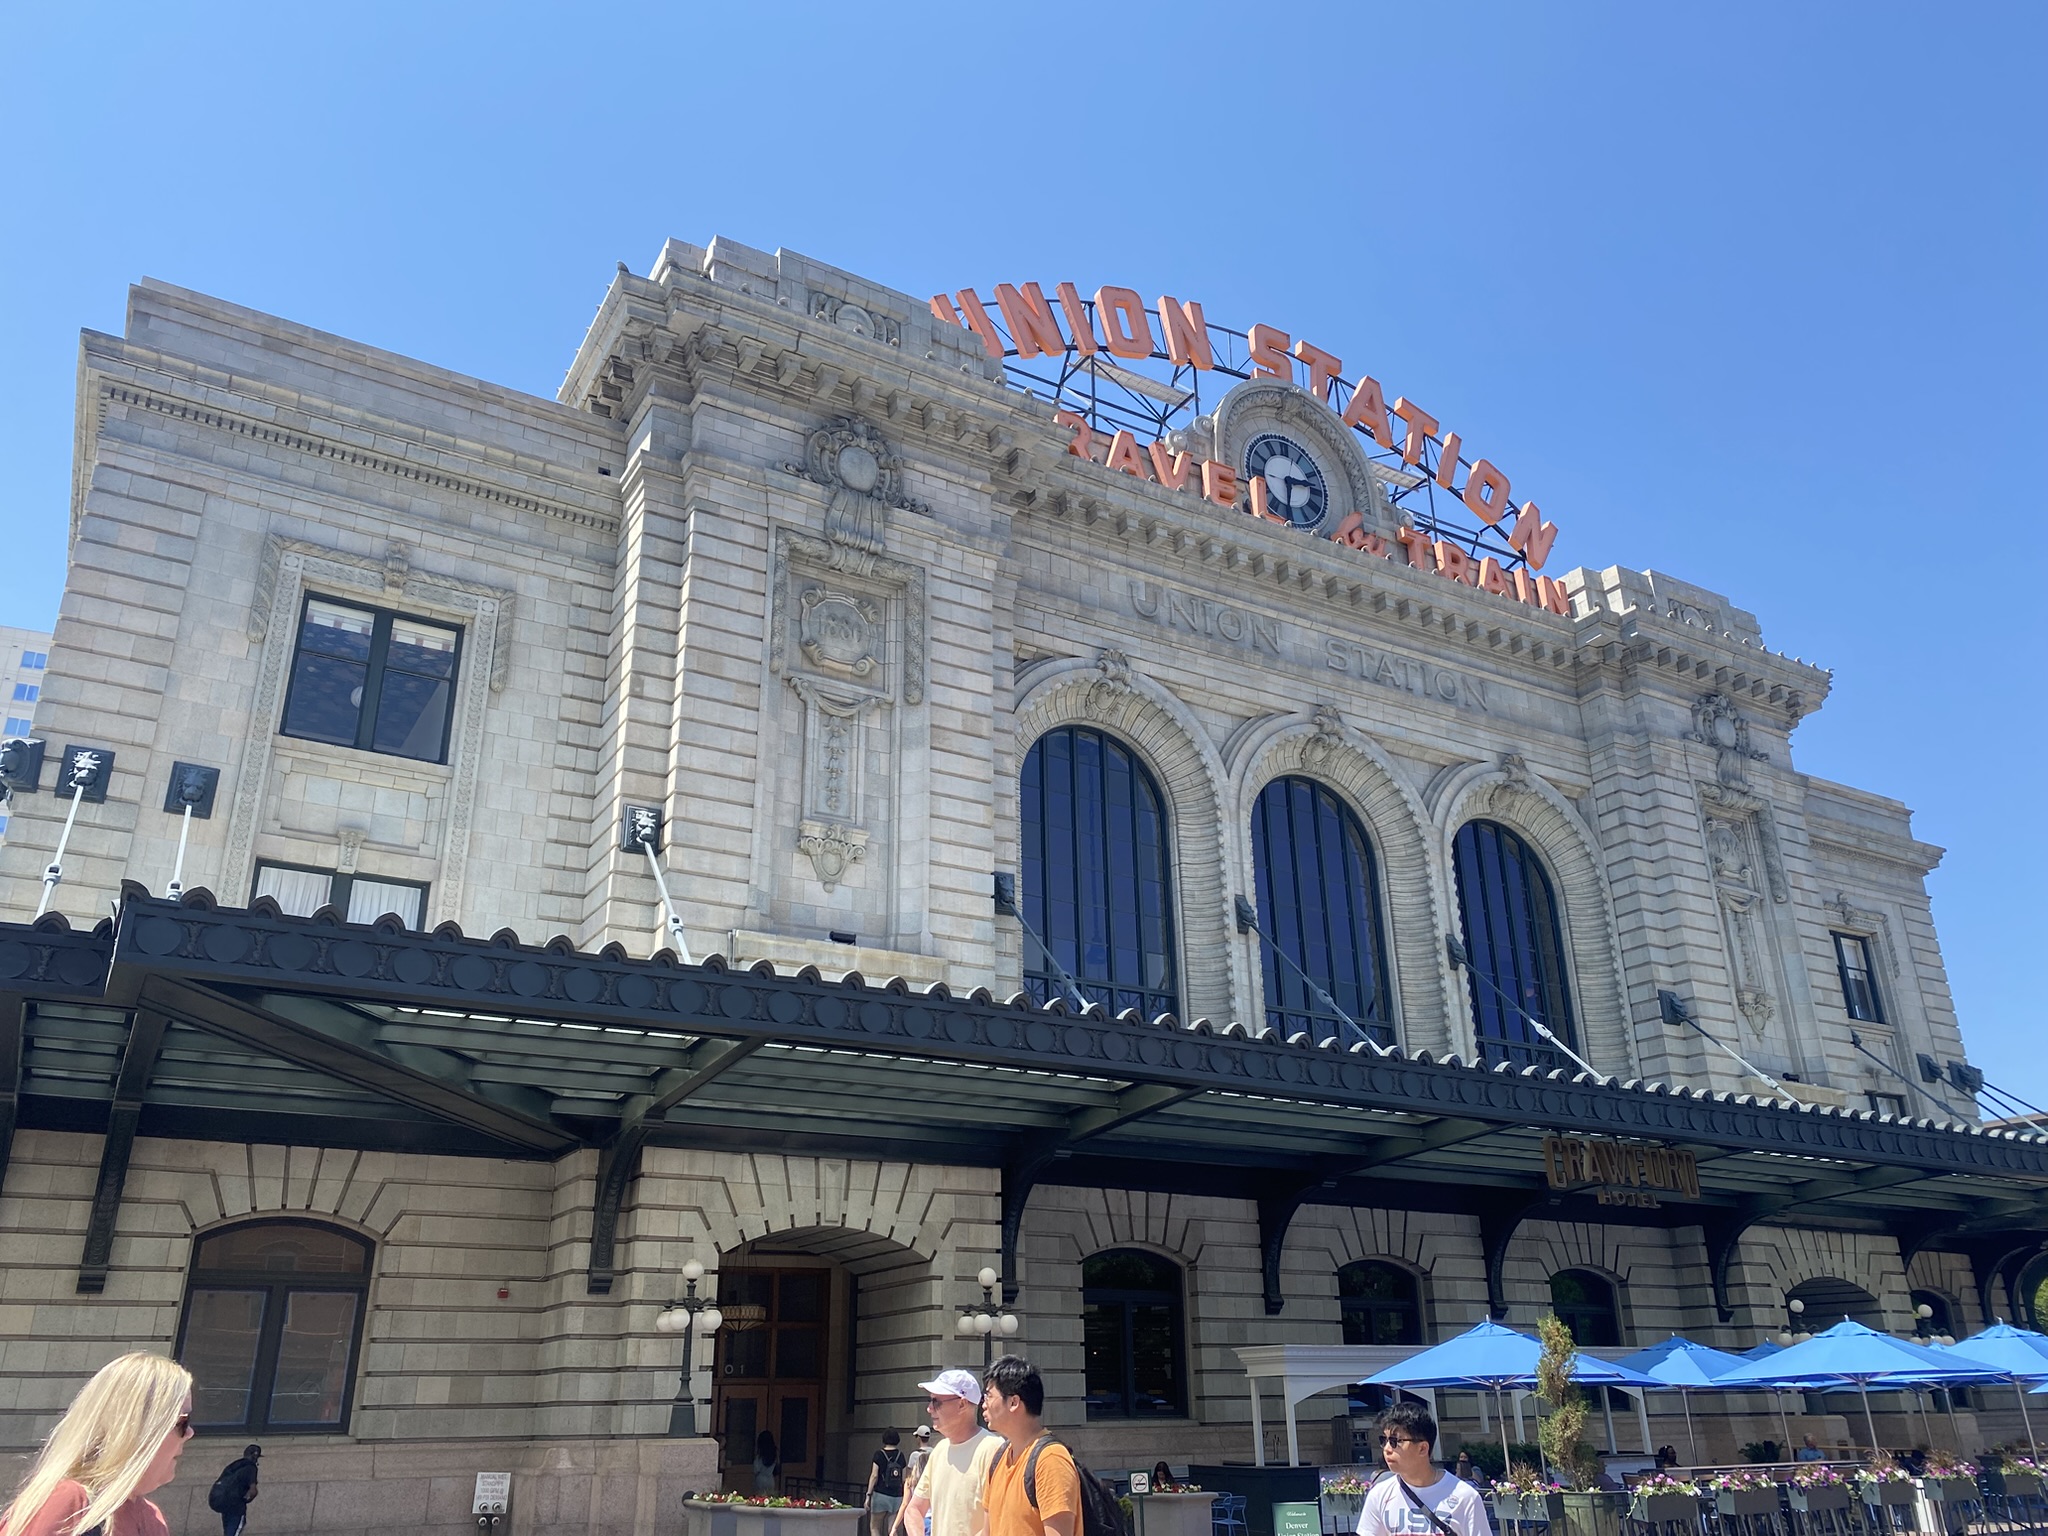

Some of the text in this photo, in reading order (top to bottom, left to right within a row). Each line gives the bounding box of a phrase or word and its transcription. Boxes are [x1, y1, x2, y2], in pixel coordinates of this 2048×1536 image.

[929, 281, 1214, 371] UNION
[1248, 323, 1558, 571] STATION
[1397, 526, 1571, 618] TRAIN
[1129, 580, 1490, 711] UNION STATION
[1541, 1136, 1701, 1200] CRAWFORD
[1597, 1190, 1662, 1209] HOTEL
[1286, 1522, 1308, 1530] Denver
